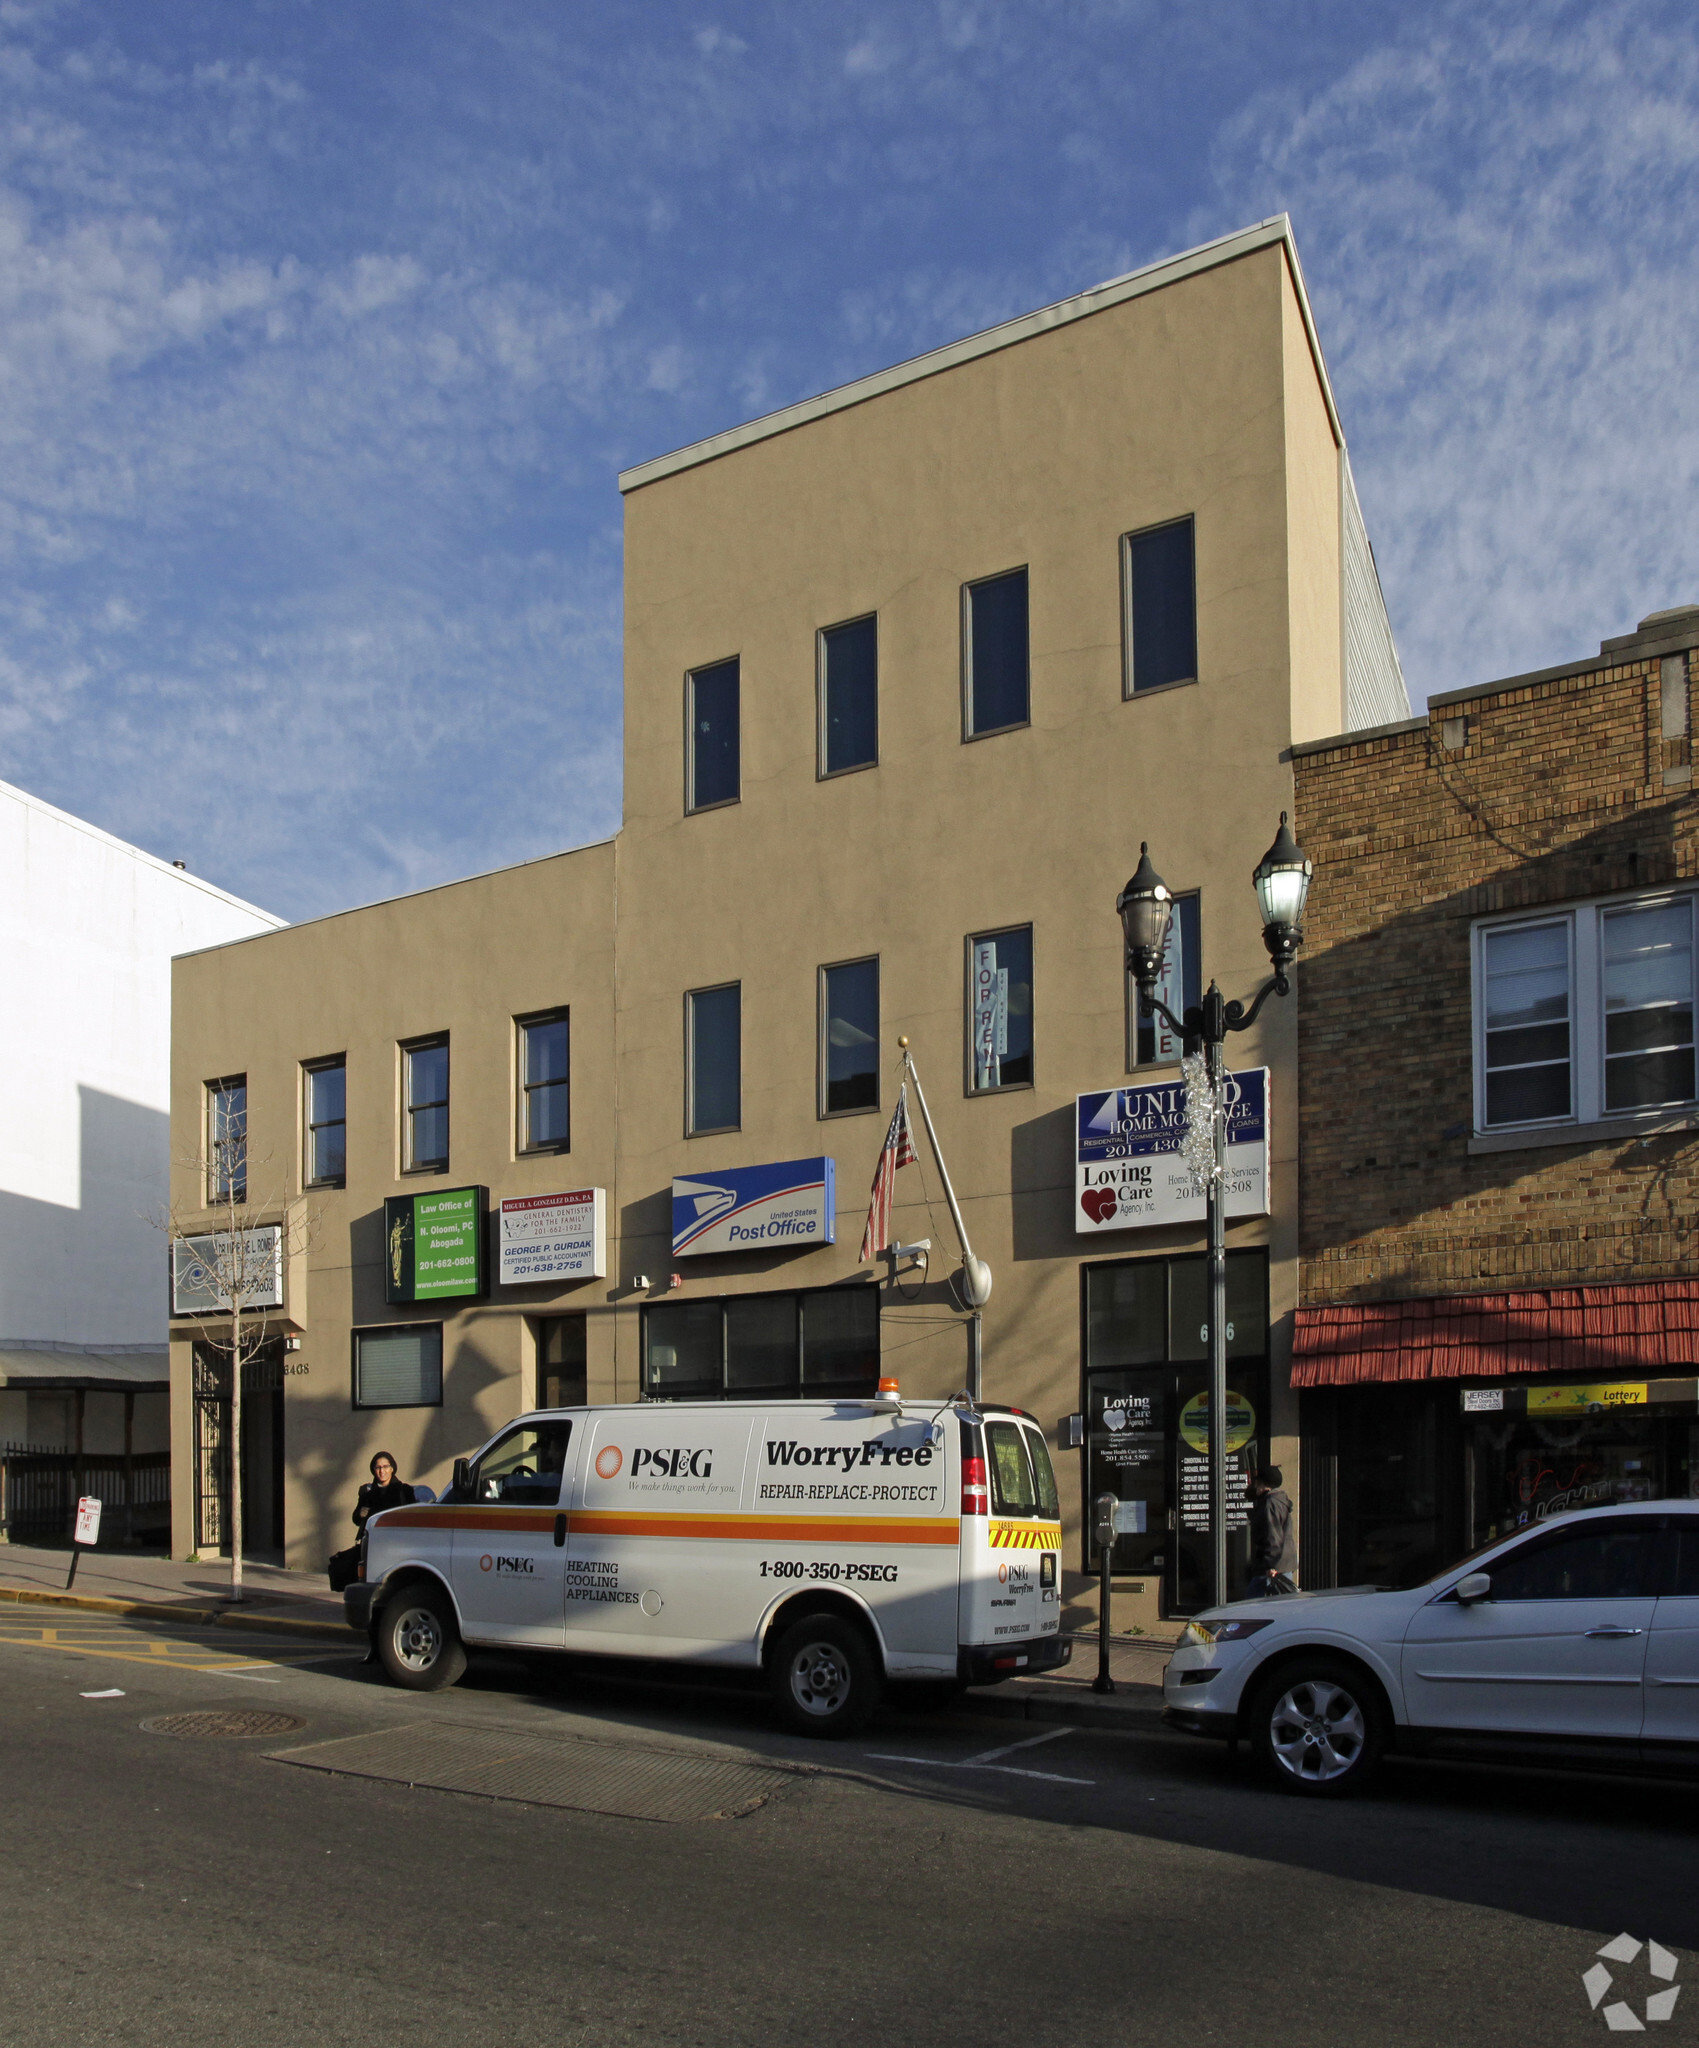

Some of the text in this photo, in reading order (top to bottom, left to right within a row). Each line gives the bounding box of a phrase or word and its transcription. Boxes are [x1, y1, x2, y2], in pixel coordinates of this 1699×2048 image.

[979, 951, 991, 1003] FOR
[982, 1010, 994, 1080] RENT
[1123, 1082, 1241, 1118] UNID
[1084, 1137, 1124, 1147] RESIDENTIAL
[1129, 1131, 1172, 1141] COMMERCIAL
[1232, 1118, 1260, 1128] LOANS
[1110, 1116, 1157, 1135] HOME
[1106, 1144, 1132, 1158] 201
[1084, 1162, 1152, 1187] Loving
[1168, 1174, 1188, 1185] Home
[1232, 1166, 1260, 1178] Services
[1118, 1185, 1153, 1202] Care
[421, 1199, 473, 1214] Law Office of
[504, 1202, 526, 1210] MIGUEL
[533, 1197, 563, 1207] GONZALEZ
[524, 1206, 593, 1220] GENERAL DENTISTRY
[561, 1215, 586, 1224] FAMILY
[770, 1208, 817, 1220] United States
[420, 1221, 473, 1236] N. Oloomi, PC
[534, 1224, 582, 1235] 201-662-1922
[430, 1237, 464, 1248] Abogada
[504, 1240, 591, 1256] GEORGE P. GURDAK
[420, 1256, 475, 1270] 201-662-0800
[503, 1257, 532, 1265] CERTIFIED
[554, 1251, 592, 1260] ACCOUNTANT
[513, 1261, 582, 1274] 201-638-2756
[1467, 1391, 1500, 1400] JERSEY
[1604, 1389, 1640, 1401] Lottery
[1103, 1395, 1151, 1410] Loving
[1127, 1409, 1151, 1418] Care
[767, 1441, 933, 1472] WorryFree
[629, 1481, 736, 1495] We make things work for you.
[567, 1560, 619, 1574] HEATING
[759, 1561, 898, 1582] 1-800-350-PSEG
[566, 1575, 618, 1588] COOLING
[566, 1589, 639, 1604] APPLIANCES
[1009, 1583, 1034, 1596] WorryFree
